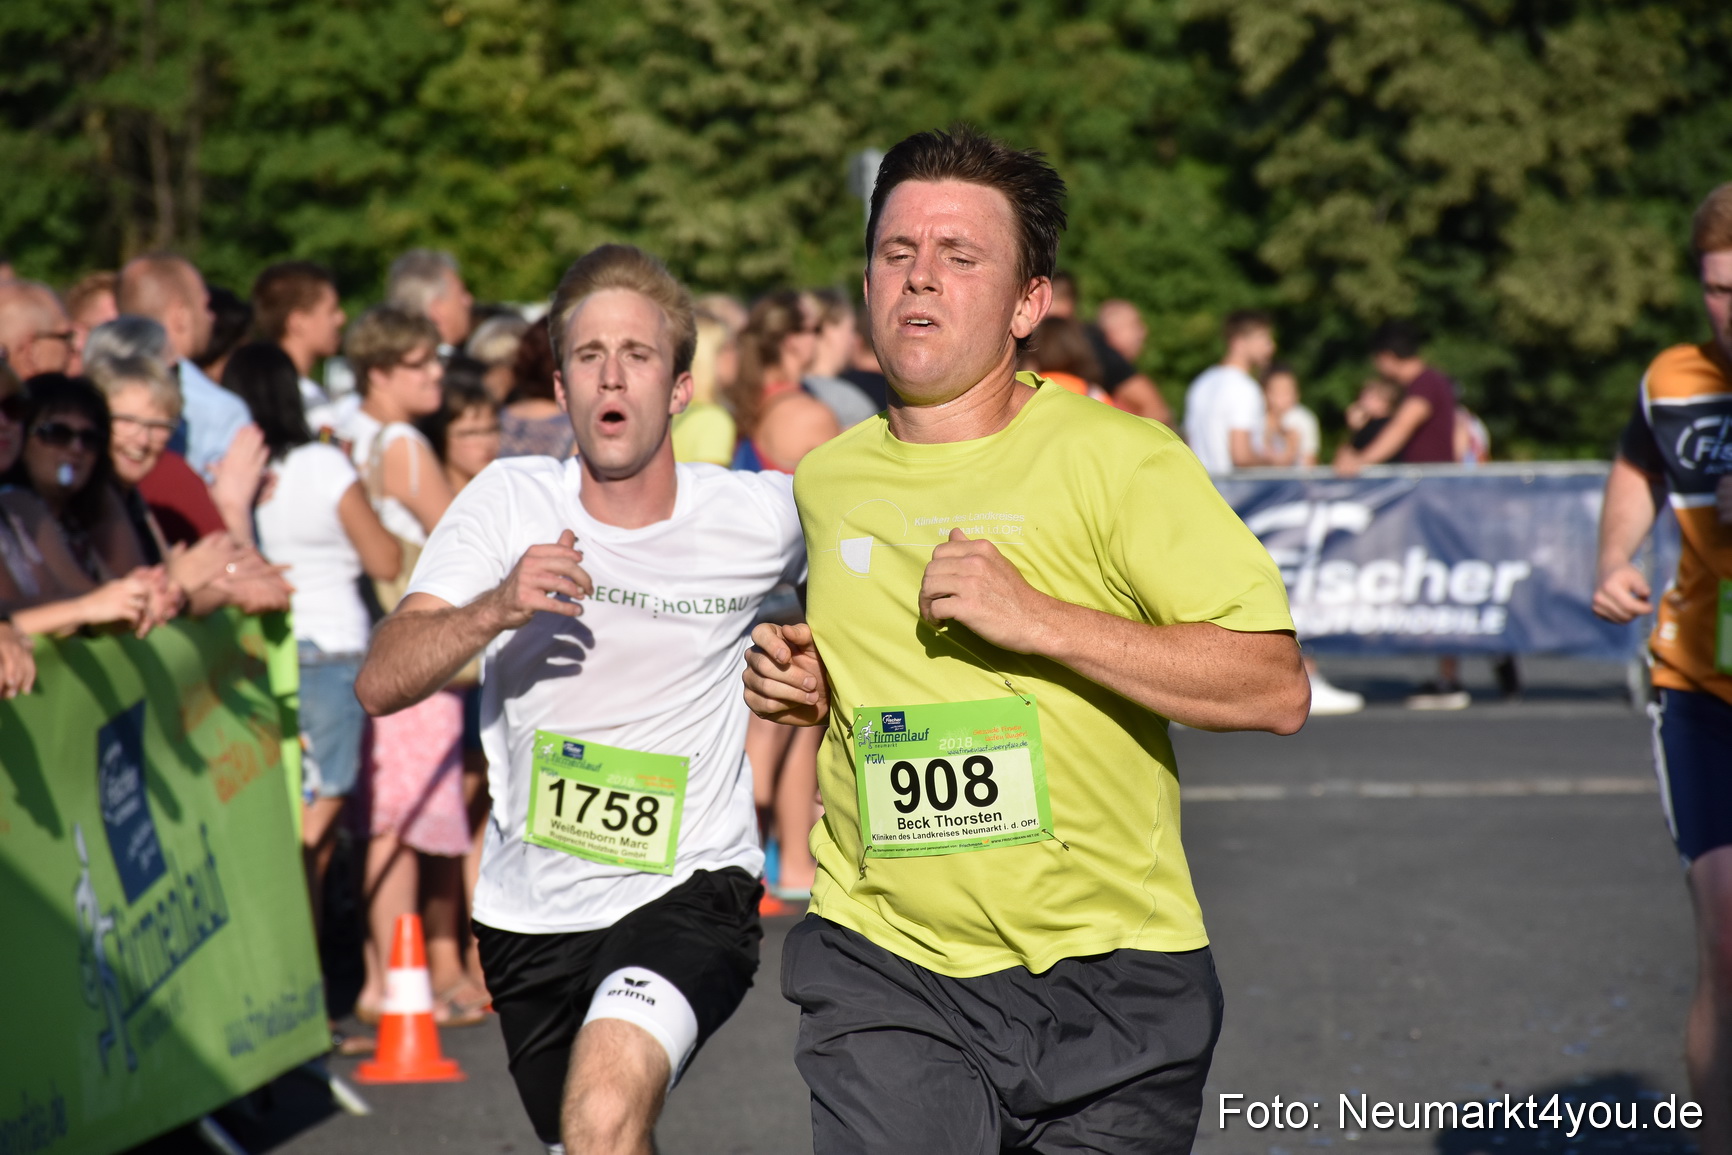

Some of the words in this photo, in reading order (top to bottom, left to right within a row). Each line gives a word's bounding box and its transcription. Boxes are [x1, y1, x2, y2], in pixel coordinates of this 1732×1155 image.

[915, 517, 950, 526] Kliniken
[952, 514, 967, 522] des
[969, 512, 1025, 522] Landkreises
[587, 585, 650, 609] ECHT
[662, 596, 749, 614] HOLZBAU
[874, 728, 930, 743] firmenlauf
[939, 736, 973, 750] 2018
[890, 755, 999, 814] 908
[549, 778, 660, 836] 1758
[872, 833, 897, 841] Kliniken
[912, 830, 960, 839] Landkreises
[962, 824, 1002, 835] Neumarkt
[1020, 818, 1039, 827] OPf.
[897, 816, 931, 830] Beck
[934, 811, 1002, 827] Thorsten
[551, 819, 616, 844] Weißenborn
[620, 837, 649, 850] Marc
[621, 849, 647, 859] GmbH
[607, 988, 656, 1006] erima
